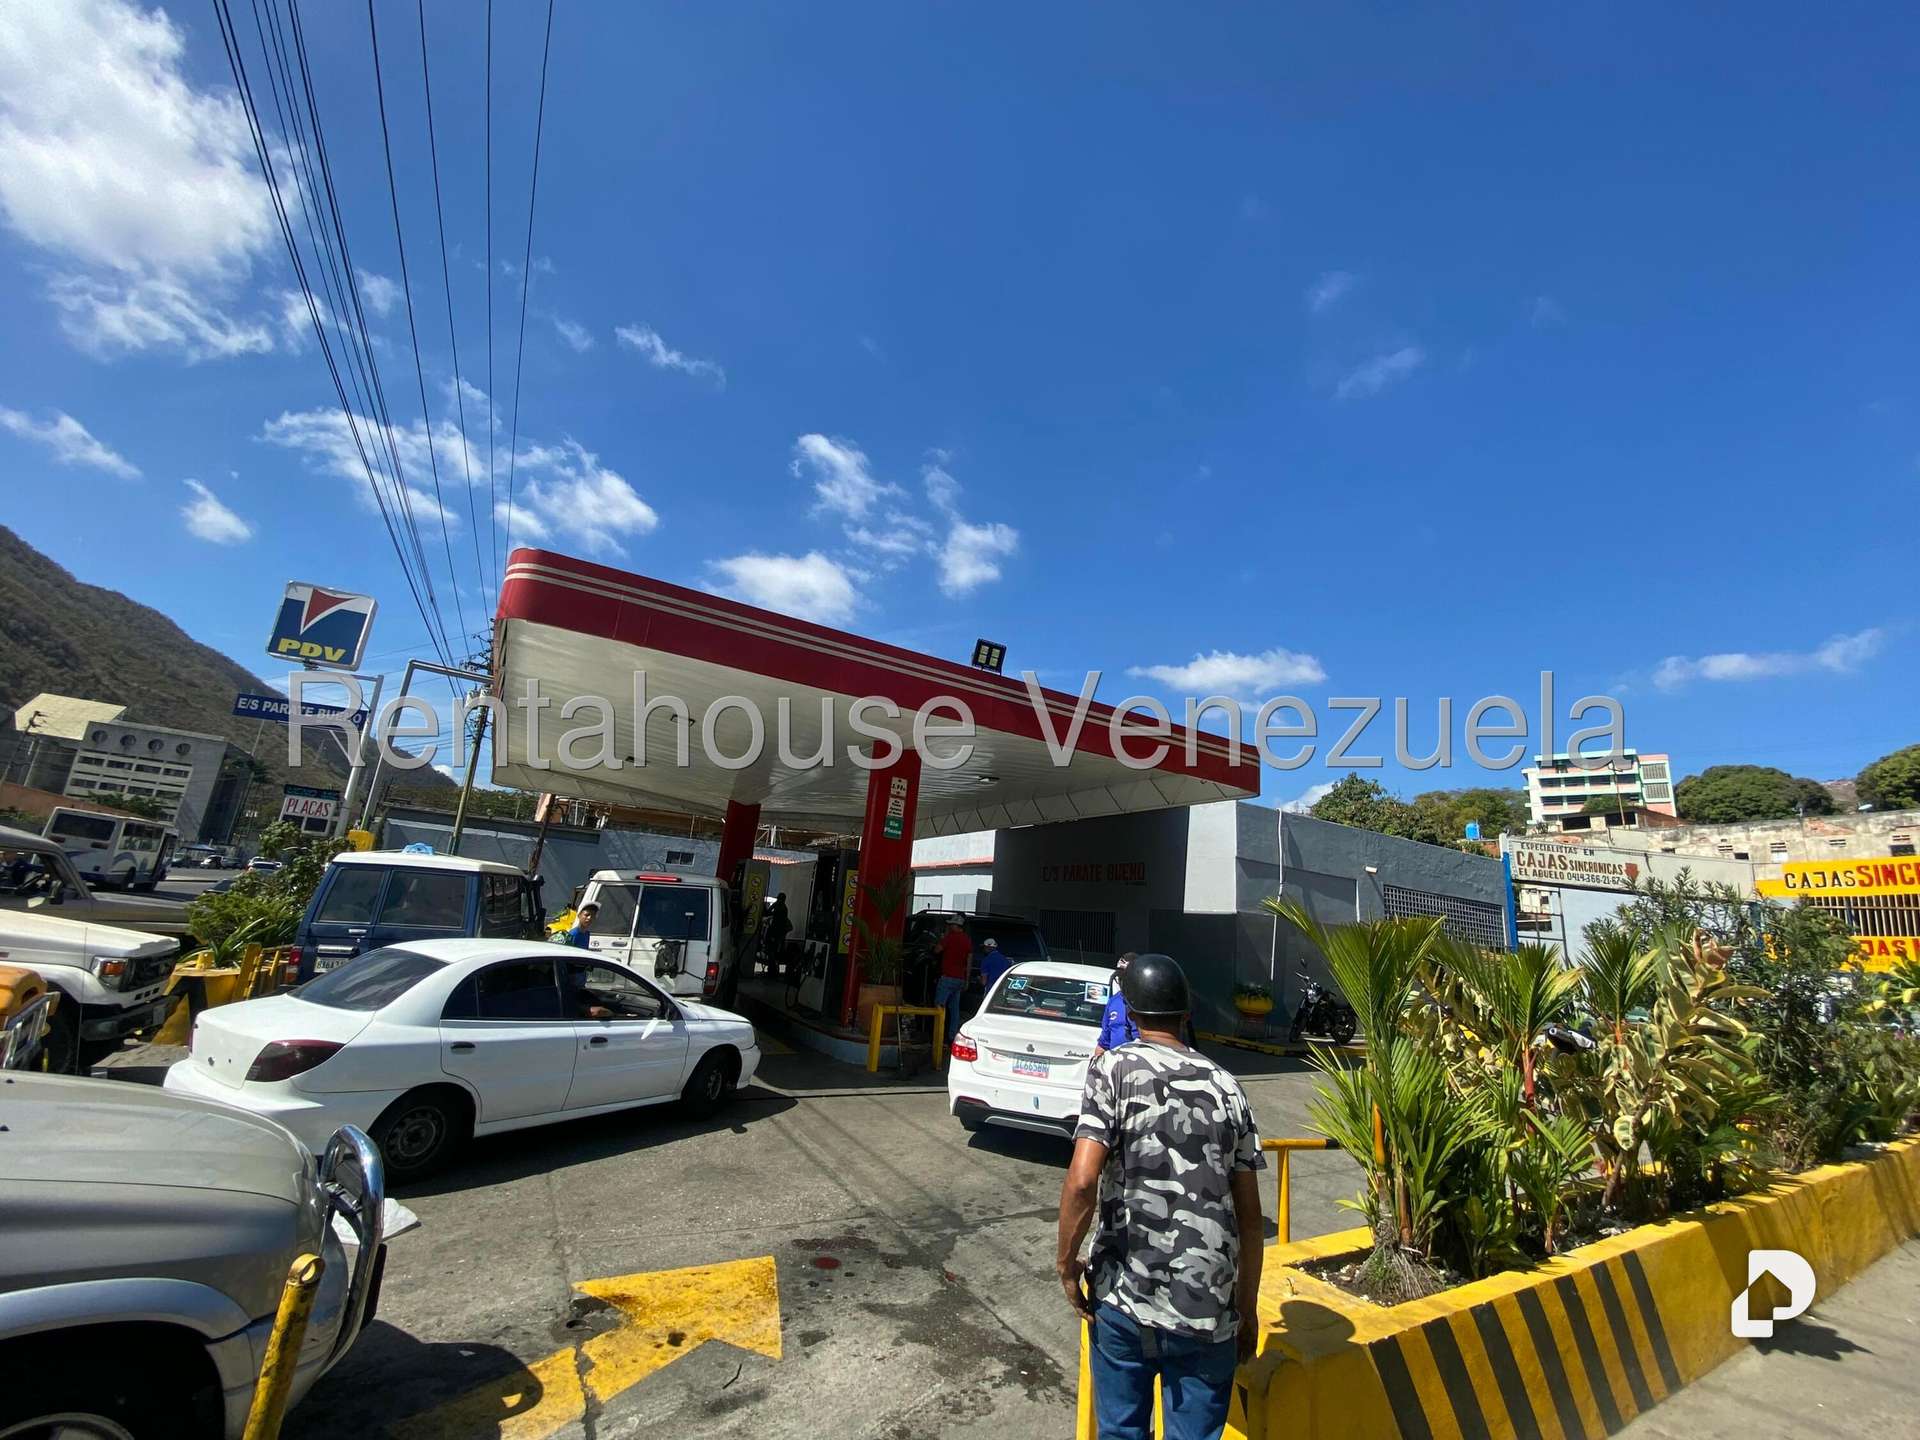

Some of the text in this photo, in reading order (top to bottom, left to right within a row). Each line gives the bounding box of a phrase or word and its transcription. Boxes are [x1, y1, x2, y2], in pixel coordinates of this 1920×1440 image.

[277, 638, 346, 661] PDV
[237, 697, 259, 711] E/S
[262, 700, 314, 716] PARTE
[286, 798, 331, 817] PLACAS
[1521, 841, 1595, 856] ESPECIALISTAS EN
[1516, 851, 1623, 875] CAJAS SINCRONICAS
[1519, 868, 1529, 876] EL
[1532, 869, 1564, 880] ABUELO
[1784, 870, 1856, 889] CAJAS
